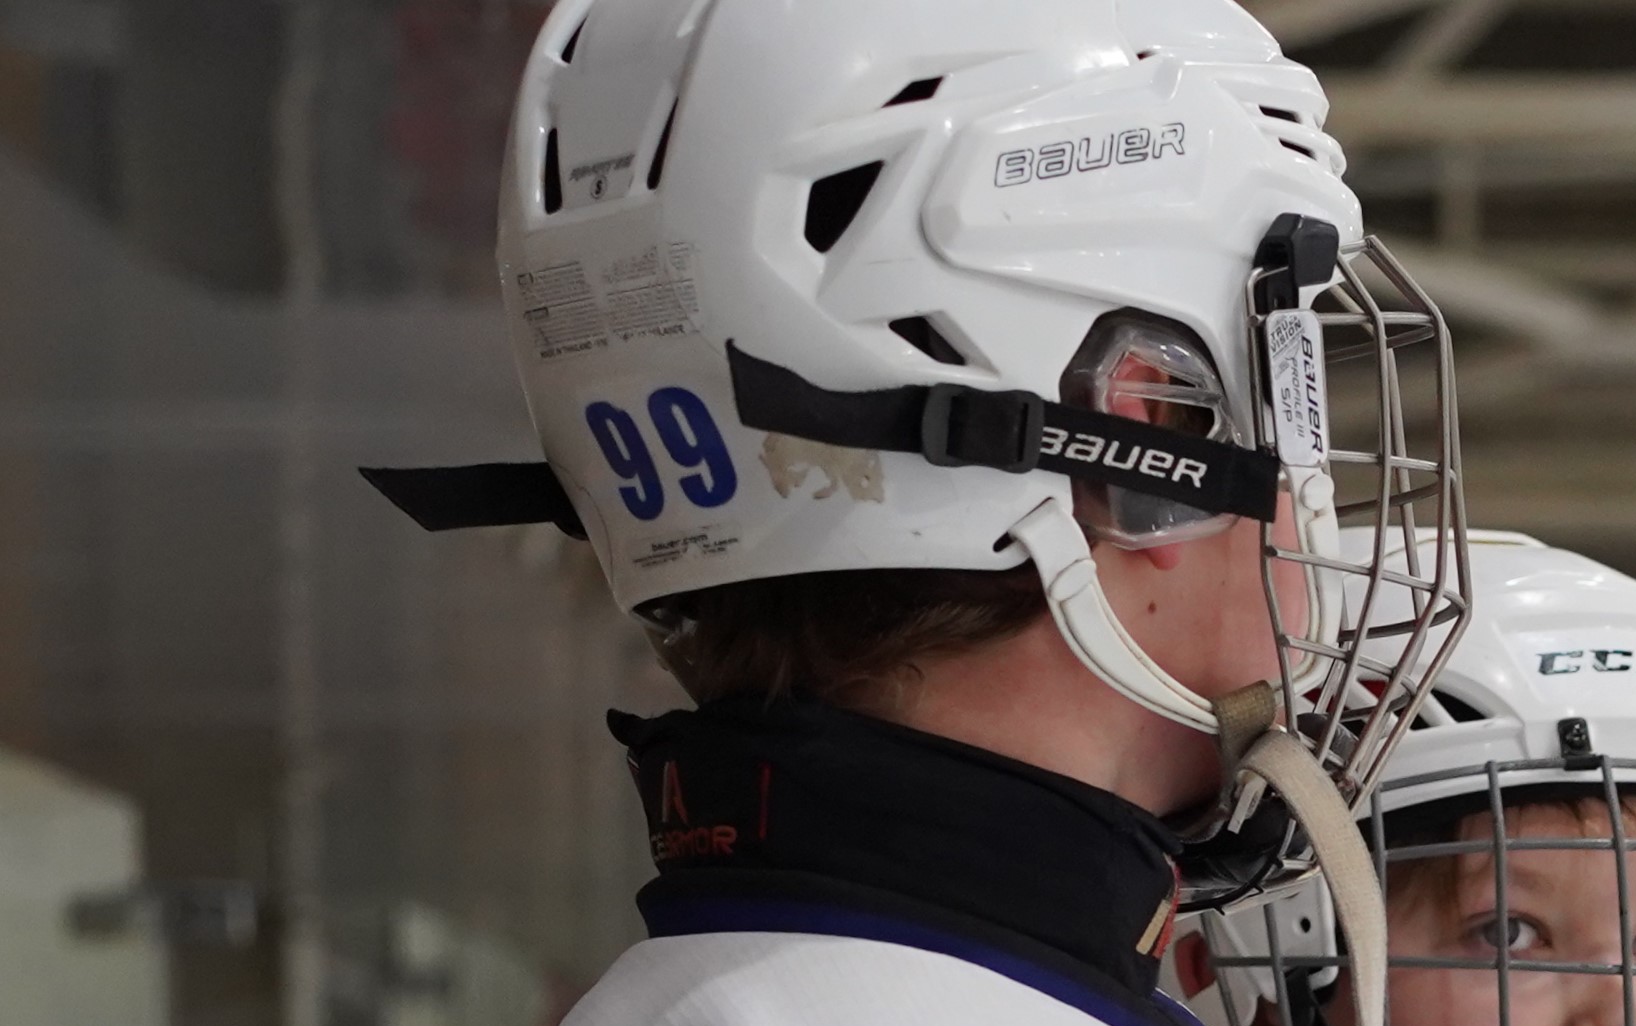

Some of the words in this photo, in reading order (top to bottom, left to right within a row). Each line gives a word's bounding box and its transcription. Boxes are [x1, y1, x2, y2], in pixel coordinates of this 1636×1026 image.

[994, 122, 1185, 188] BAUER
[1281, 387, 1293, 423] S/P
[1301, 334, 1324, 454] BAUER
[585, 386, 738, 522] 99
[1040, 426, 1208, 488] BAUER
